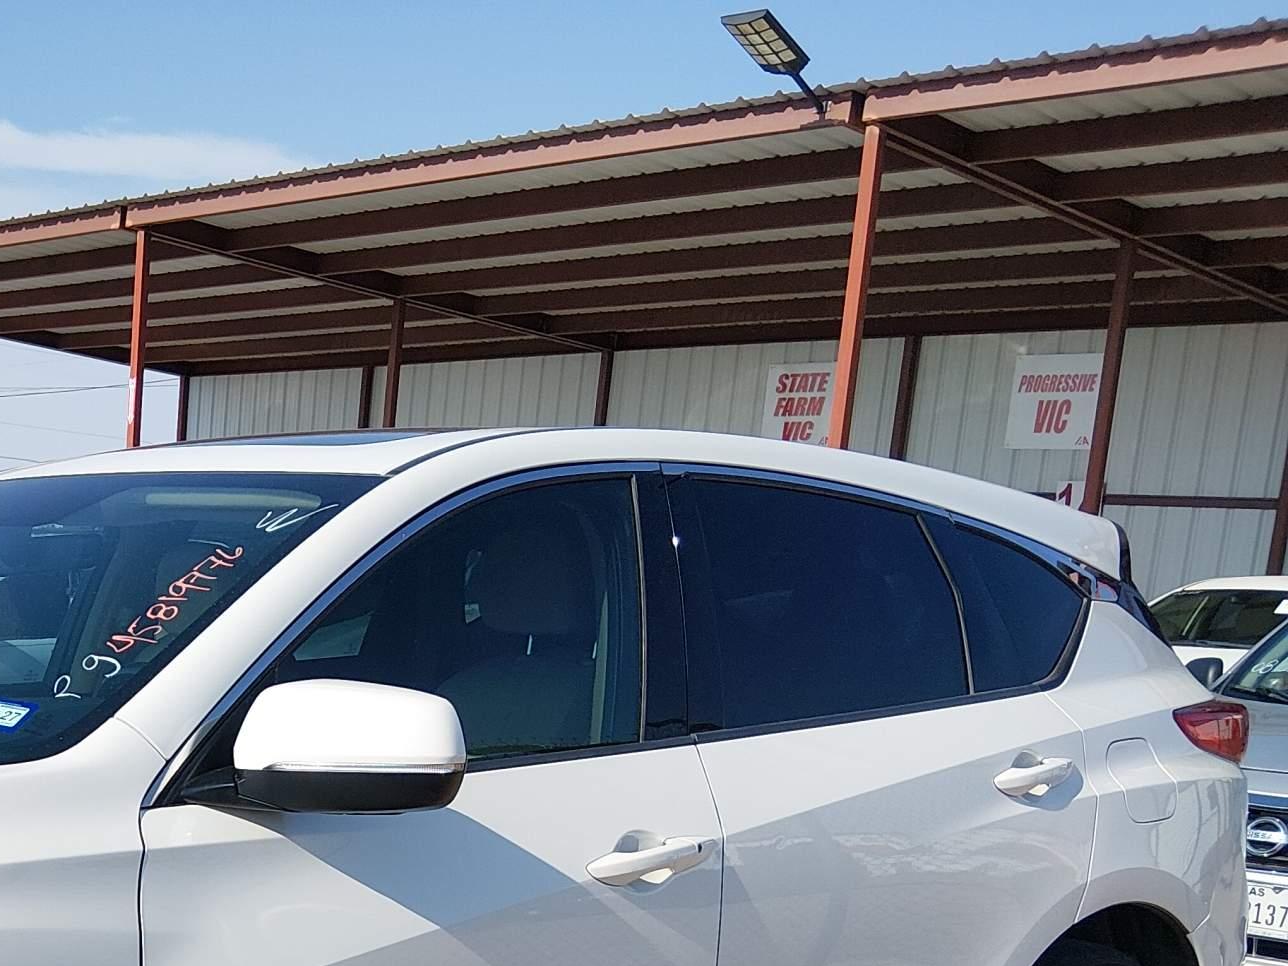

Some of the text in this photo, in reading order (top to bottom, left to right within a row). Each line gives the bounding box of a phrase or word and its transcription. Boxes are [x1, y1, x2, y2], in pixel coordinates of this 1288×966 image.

[775, 373, 830, 393] STATE
[1018, 373, 1098, 393] PROGRESSIVE
[773, 397, 825, 416] FARM
[1033, 399, 1072, 433] VIC
[781, 421, 814, 441] VIC
[1248, 902, 1288, 928] 137
